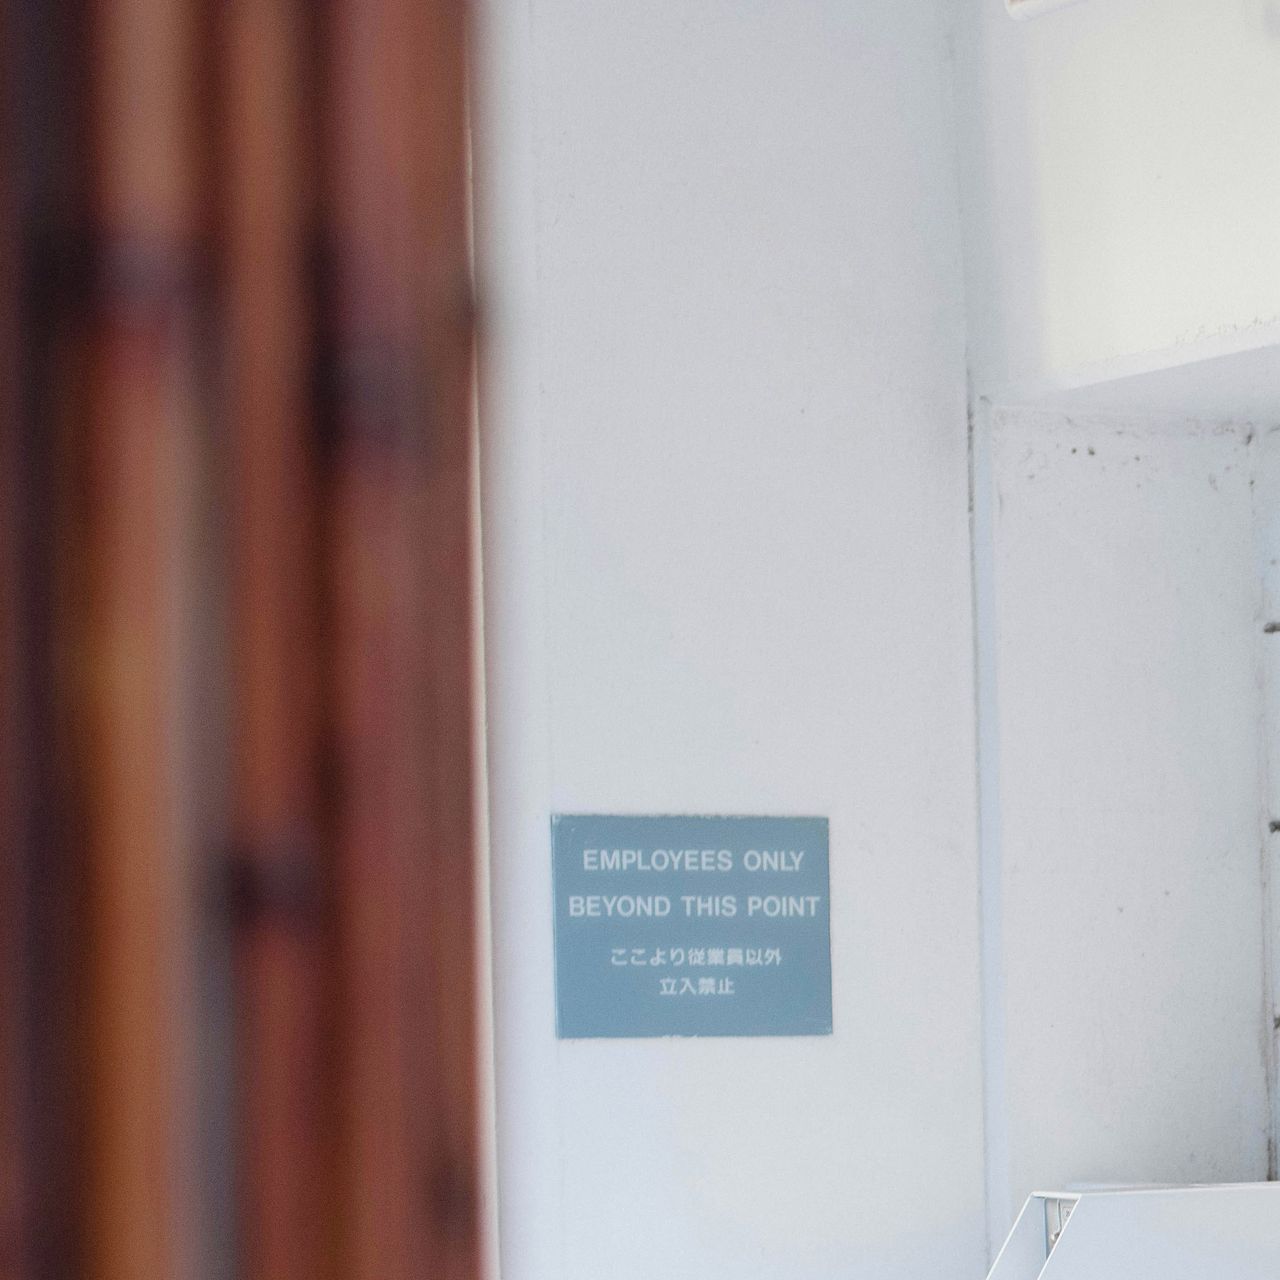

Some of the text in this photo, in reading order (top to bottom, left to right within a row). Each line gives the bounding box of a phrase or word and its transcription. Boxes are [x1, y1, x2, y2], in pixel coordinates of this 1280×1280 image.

[583, 849, 804, 872] EMPLOYEES ONLY
[568, 895, 821, 918] BEYOND THIS POINT
[611, 947, 782, 967] ここより従業員以外
[659, 977, 735, 996] 立入禁止
